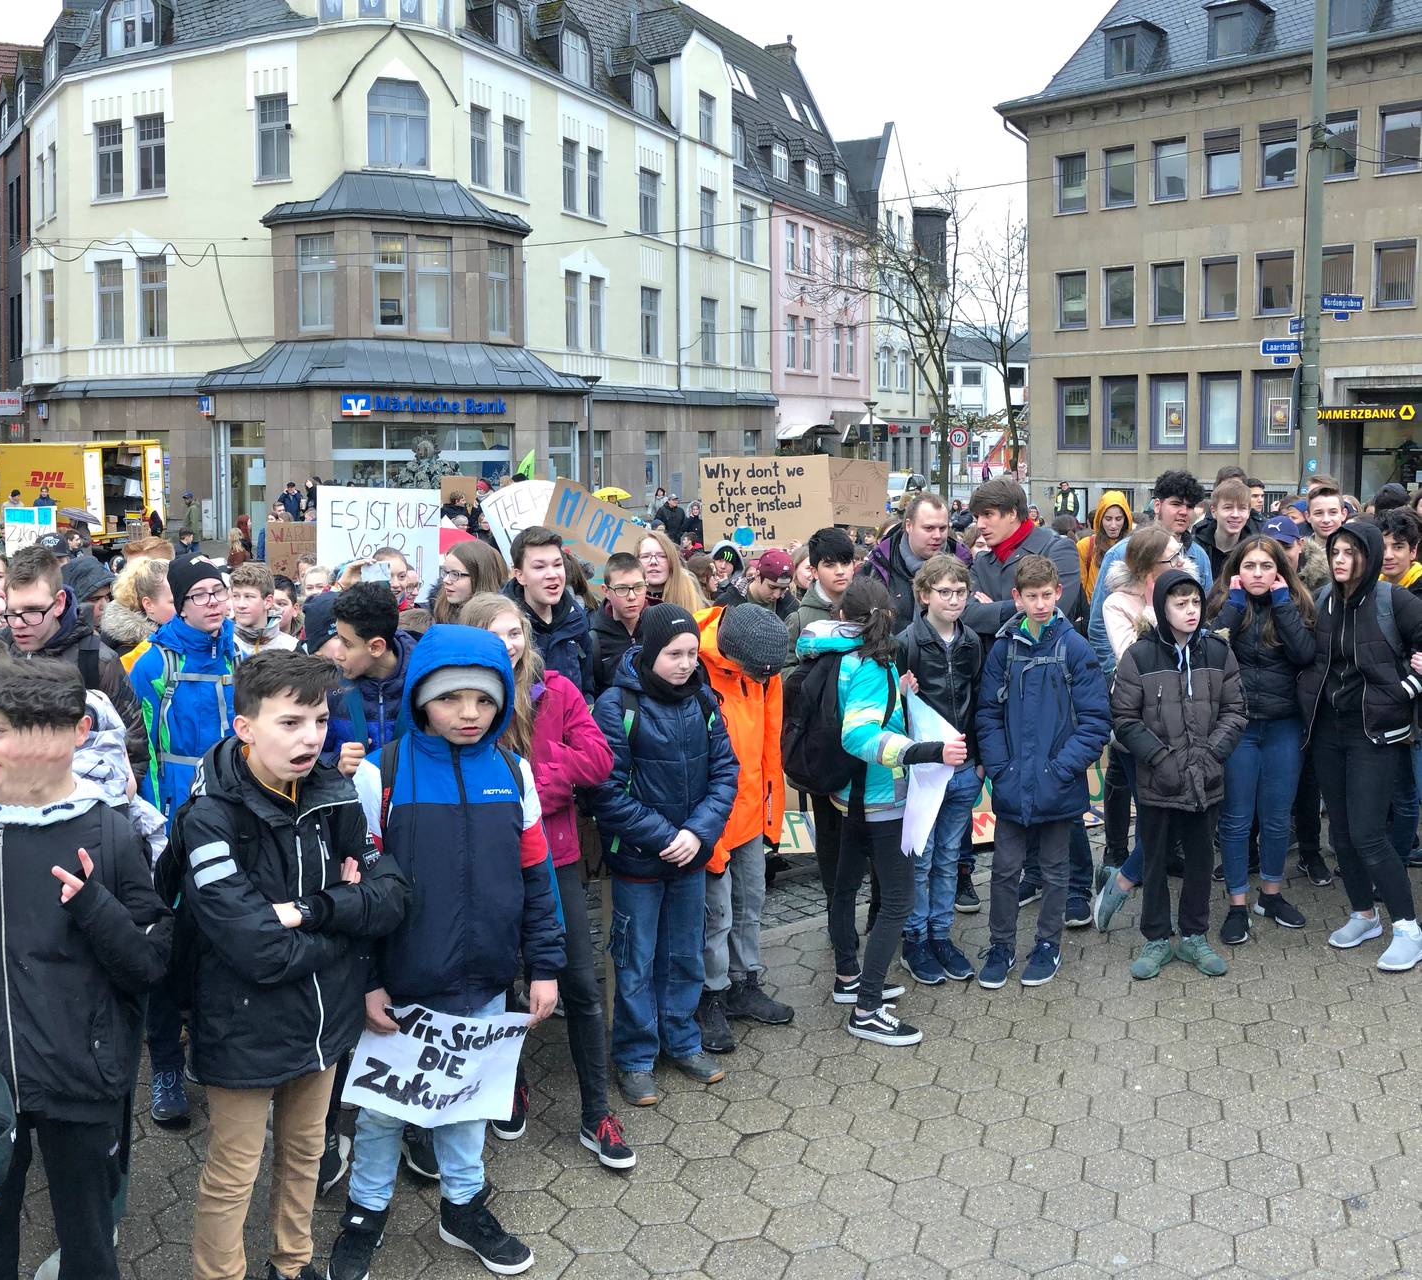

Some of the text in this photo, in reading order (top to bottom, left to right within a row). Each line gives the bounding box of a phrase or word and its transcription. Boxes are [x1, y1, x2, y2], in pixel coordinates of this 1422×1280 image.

[374, 395, 507, 415] Märkische Bank
[1316, 408, 1396, 420] OMMERZBANK
[30, 470, 67, 489] DHL
[704, 461, 805, 482] Why don't we
[717, 480, 786, 496] fuck each
[709, 494, 802, 514] other instead
[330, 500, 440, 531] ES IST KURZ
[725, 513, 767, 527] of the
[348, 532, 380, 558] Vor
[417, 1045, 467, 1080] DIE
[352, 1057, 482, 1110] Zukunft
